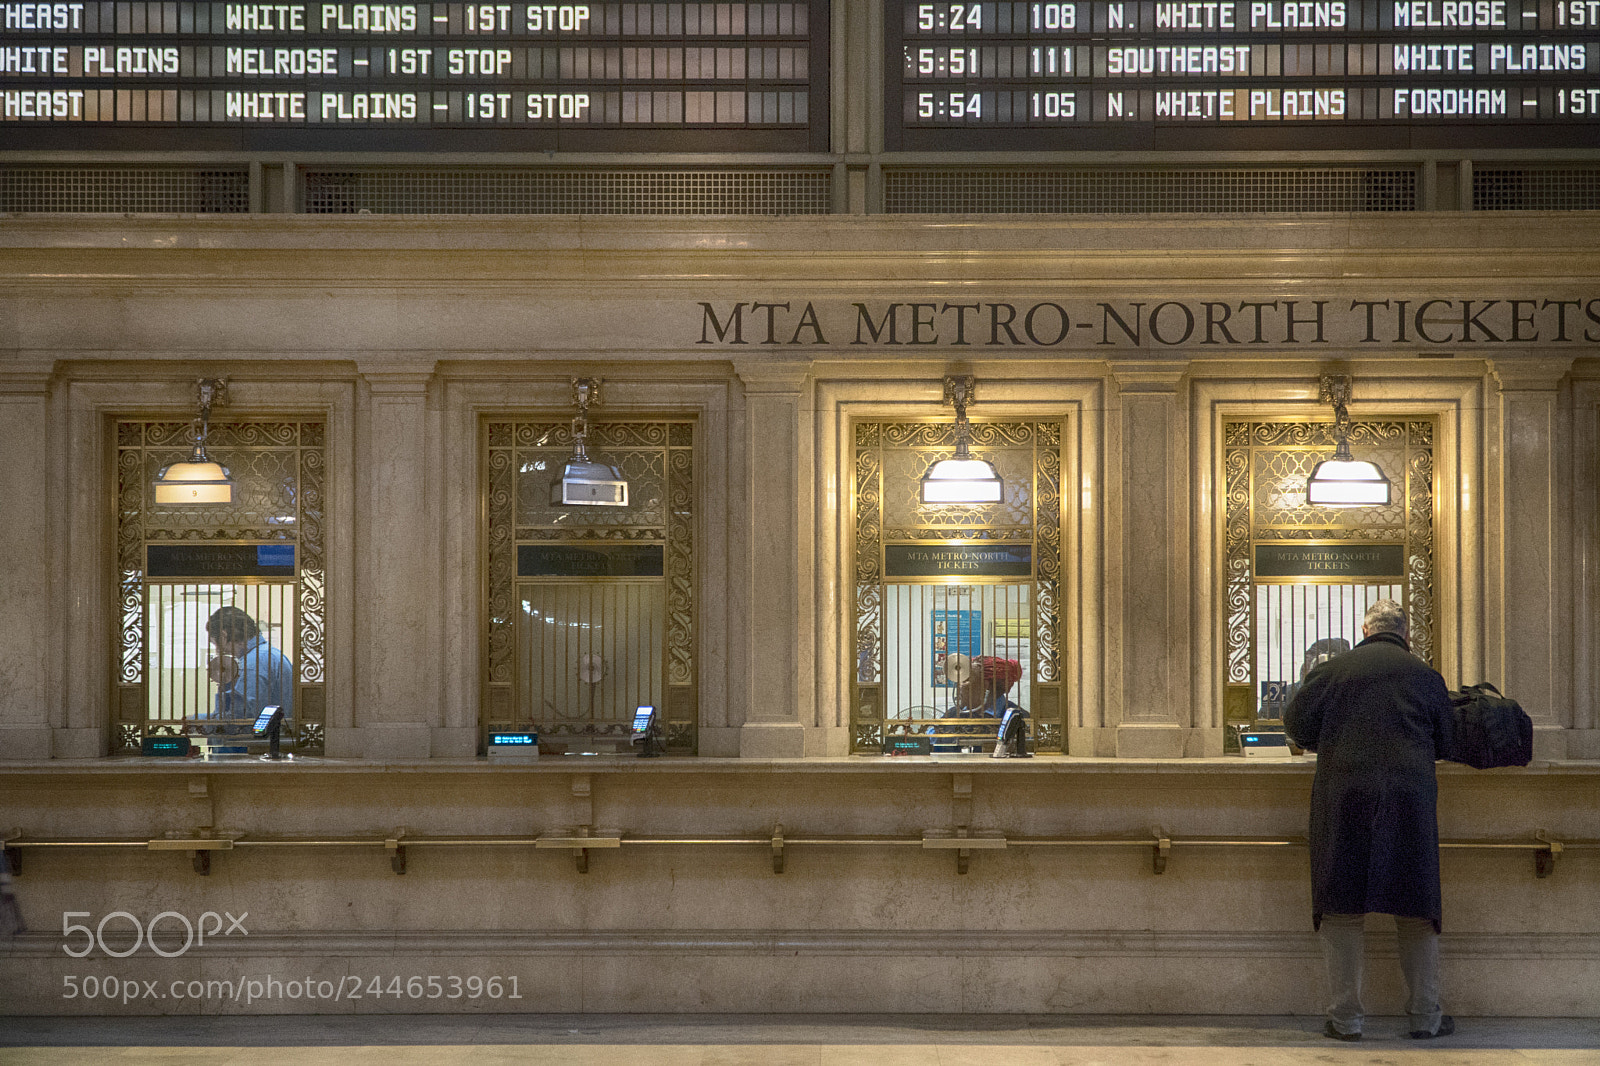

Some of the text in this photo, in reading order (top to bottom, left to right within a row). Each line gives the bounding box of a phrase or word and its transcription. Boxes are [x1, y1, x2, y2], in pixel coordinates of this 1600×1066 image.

[226, 4, 305, 31] WHITE
[322, 4, 416, 32] PLAINS
[467, 5, 511, 31] 1ST
[527, 5, 590, 31] STOP
[919, 2, 1346, 30] 5:24 108 N. WHITE PLAINS
[1394, 1, 1506, 27] MELROSE
[1557, 1, 1600, 26] 1ST
[84, 47, 179, 73] PLAINS
[226, 47, 338, 75] MELROSE
[388, 48, 432, 74] 1ST
[448, 49, 512, 75] STOP
[918, 46, 1250, 74] 5:51 111 SOUTHEAST
[1394, 44, 1585, 71] WHITE PLAINS
[226, 92, 305, 118] WHITE
[322, 93, 416, 119] PLAINS
[467, 93, 511, 119] 1ST
[527, 94, 590, 119] STOP
[918, 90, 1345, 118] 5:54 105 N. WHITE PLAINS
[1394, 89, 1506, 114] FORDHAM
[1558, 89, 1600, 114] 1ST
[695, 298, 1600, 346] MTA METRO-NORTH TICKETS
[907, 552, 929, 560] MTA
[937, 561, 979, 569] TICKETS
[1278, 552, 1300, 561] MTA
[1307, 561, 1351, 570] TICKETS
